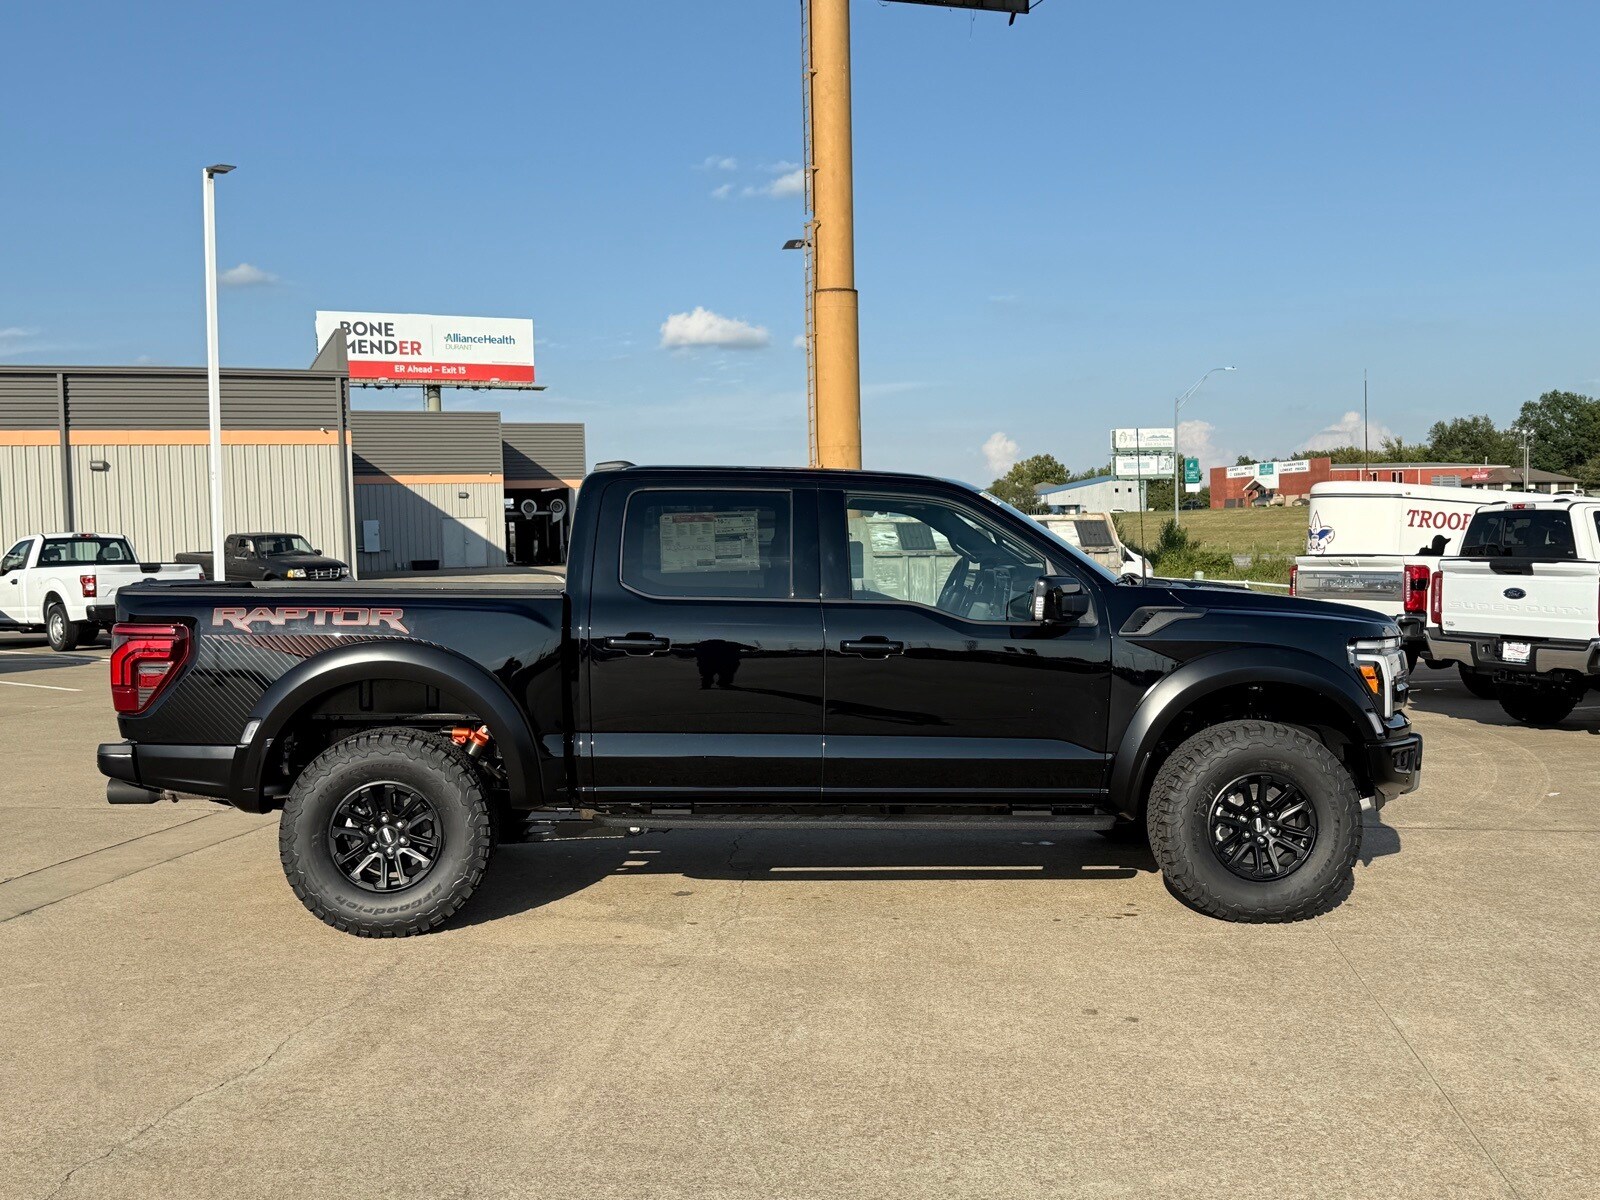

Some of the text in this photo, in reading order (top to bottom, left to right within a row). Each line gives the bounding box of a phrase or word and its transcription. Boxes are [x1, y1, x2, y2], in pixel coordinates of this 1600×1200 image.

[340, 321, 395, 337] BONE
[445, 333, 516, 345] AllianceHealth
[445, 343, 473, 351] DURANT
[394, 365, 405, 373] ER
[407, 365, 433, 374] Ahead
[441, 365, 457, 375] Exit
[458, 366, 467, 375] 15
[1449, 600, 1589, 616] SUPER DUTY
[212, 607, 410, 635] RAPTOR
